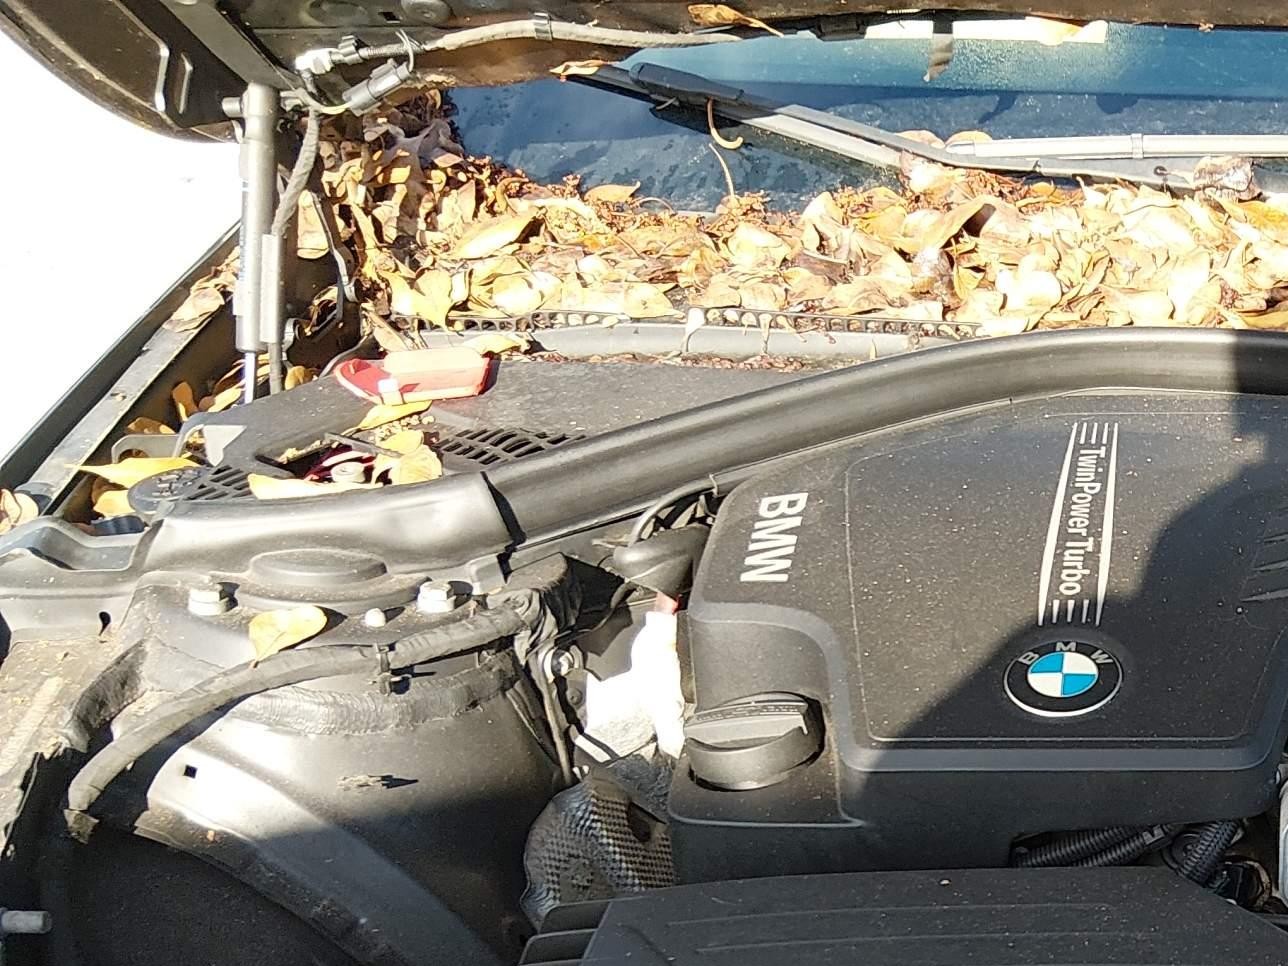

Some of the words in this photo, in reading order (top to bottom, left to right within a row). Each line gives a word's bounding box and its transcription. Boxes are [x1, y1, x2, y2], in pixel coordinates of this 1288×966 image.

[1067, 446, 1107, 536] TwinPower
[740, 492, 809, 582] BMW
[1058, 537, 1095, 596] Turbo
[1018, 641, 1114, 665] BMW
